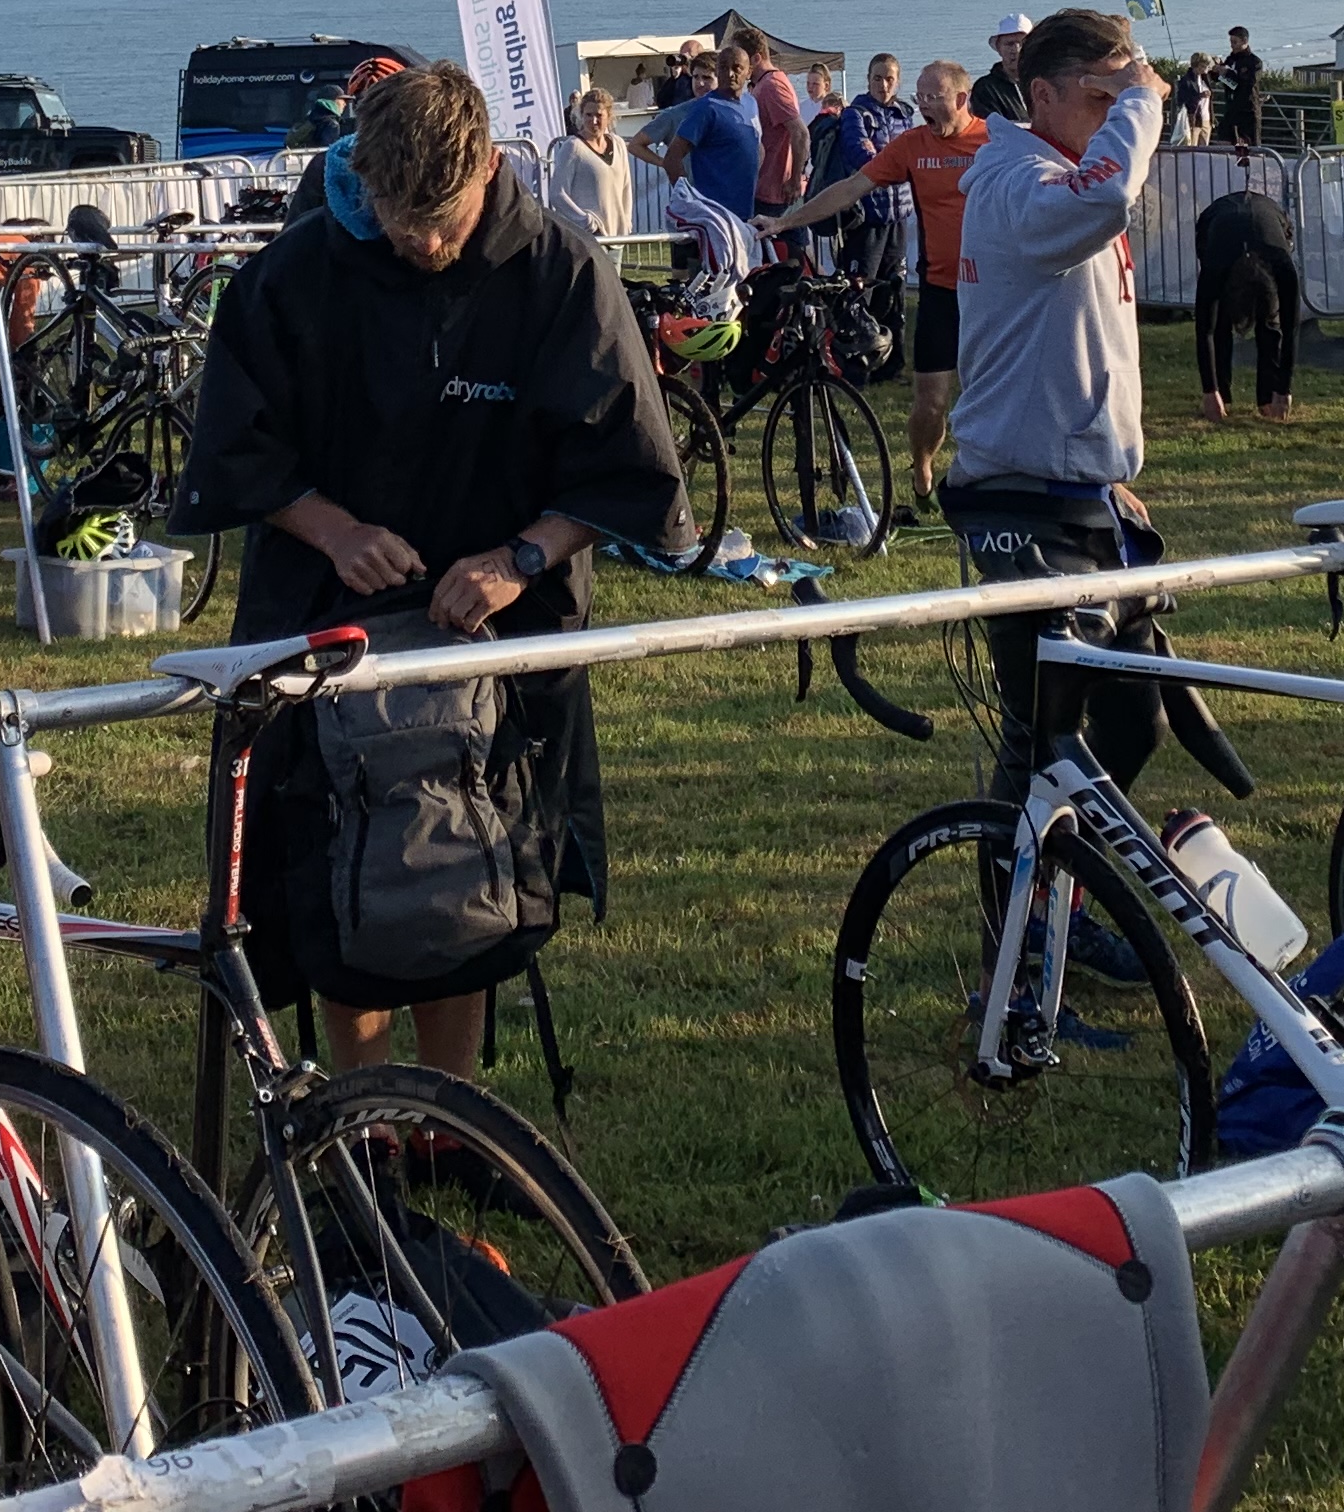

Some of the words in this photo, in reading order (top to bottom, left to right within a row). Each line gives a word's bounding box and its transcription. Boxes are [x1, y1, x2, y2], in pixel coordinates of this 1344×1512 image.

[192, 73, 296, 86] holidayhome-owner.com
[908, 823, 984, 862] PR-2
[1068, 789, 1246, 956] GIANT
